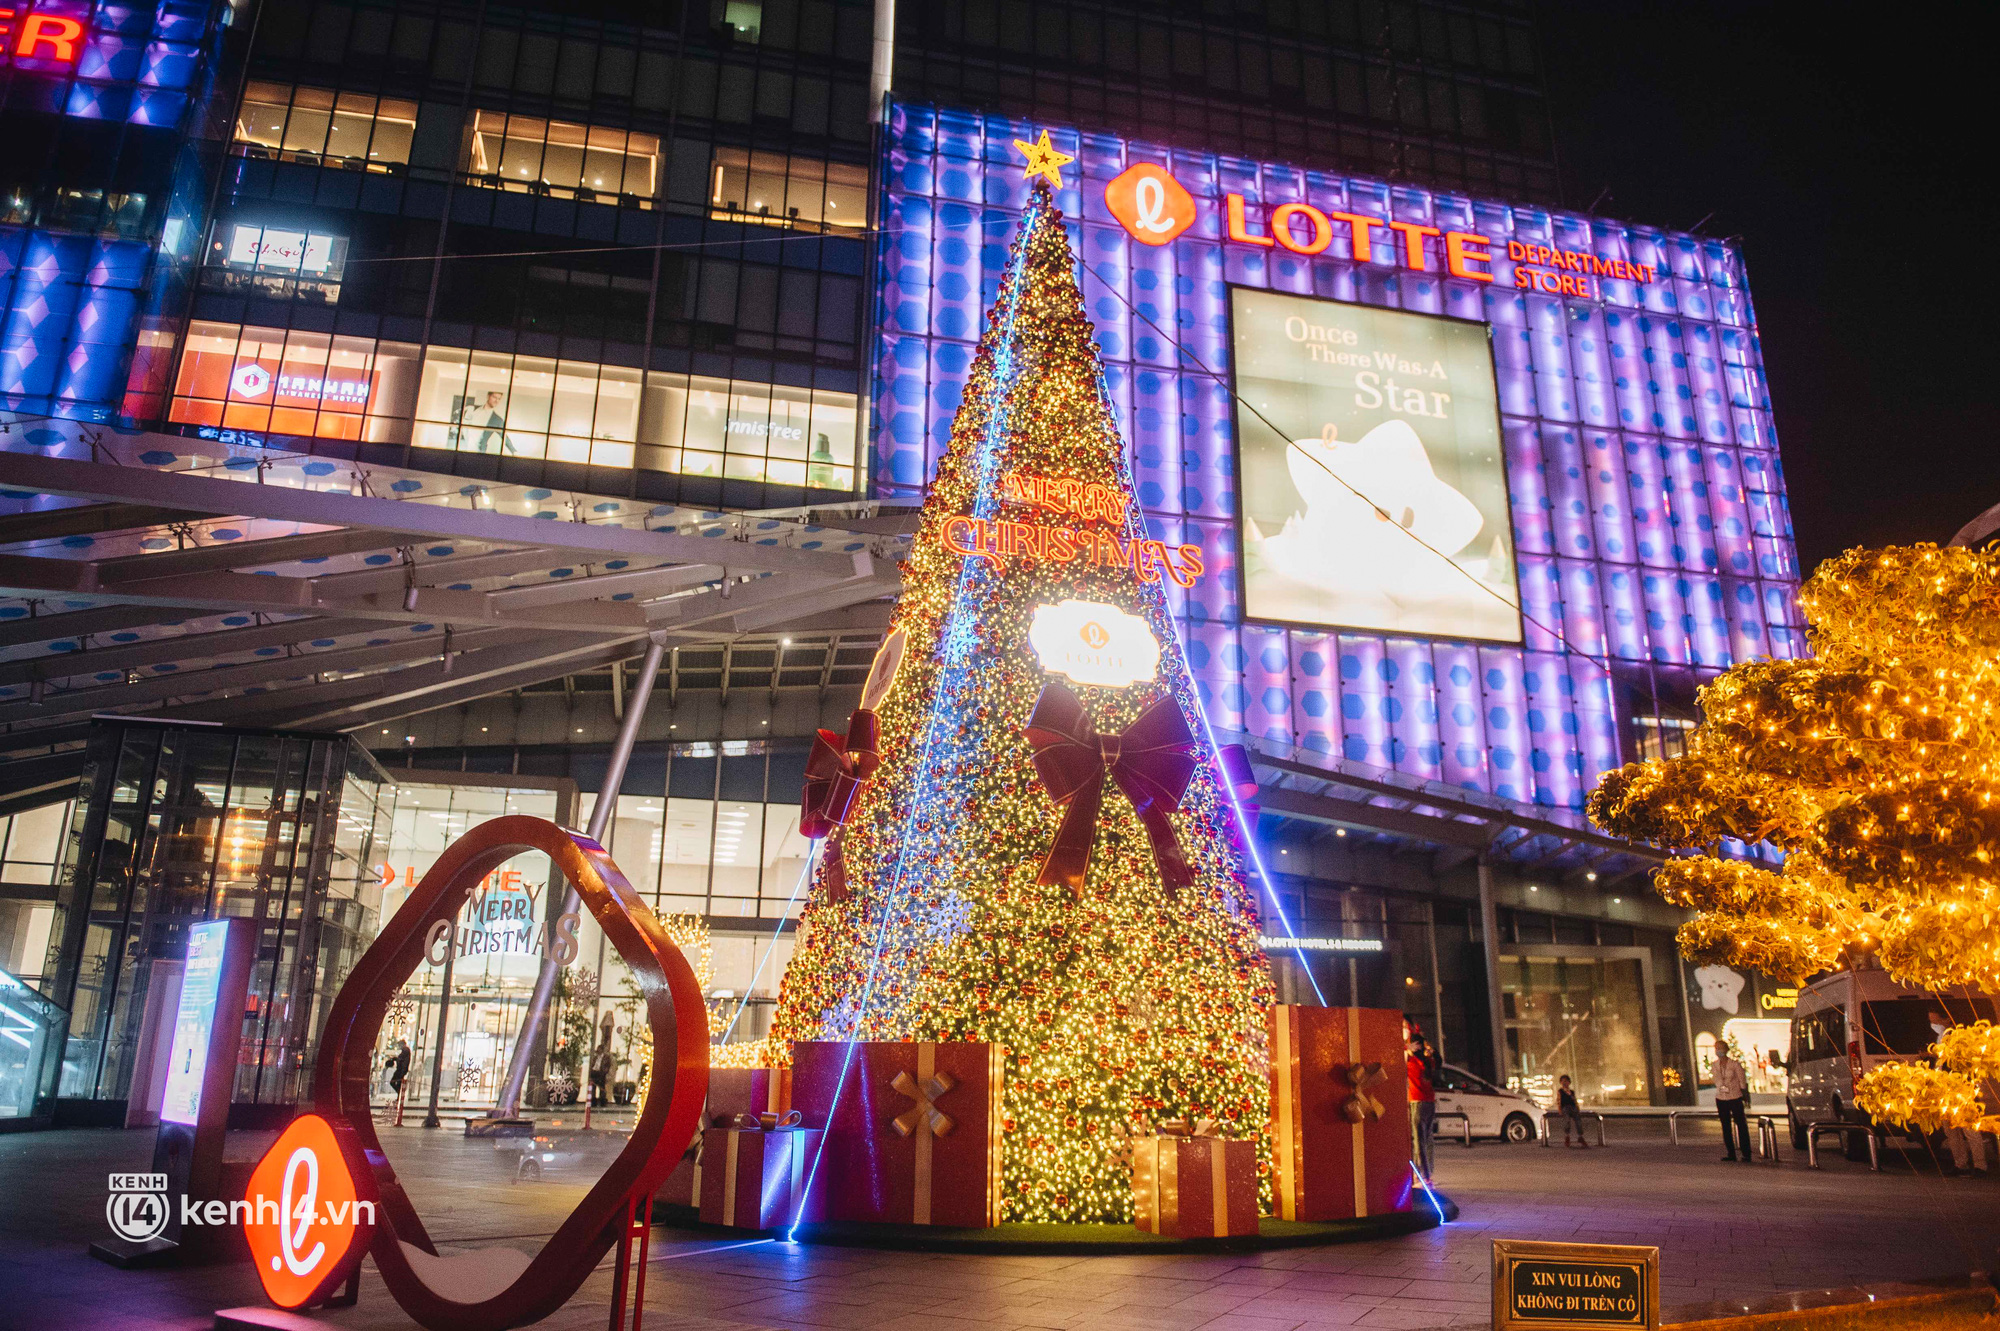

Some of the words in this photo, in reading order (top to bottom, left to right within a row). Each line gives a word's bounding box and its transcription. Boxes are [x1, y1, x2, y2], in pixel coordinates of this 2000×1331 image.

[0, 8, 83, 61] R
[1227, 193, 1494, 282] LOTTE
[1508, 240, 1656, 283] DEPARTMENT
[1514, 266, 1591, 298] STORE
[1285, 316, 1358, 346] Once
[1306, 343, 1371, 369] There
[279, 376, 369, 397] MANWAH
[332, 394, 364, 404] HOTPO
[1354, 371, 1450, 419] Star
[724, 418, 802, 441] innisfree
[1004, 473, 1130, 525] MERRY
[941, 515, 1205, 588] CHRISTMAS
[404, 866, 522, 892] LTE
[465, 881, 546, 924] MERRY
[424, 913, 581, 967] CHRISTMAS
[1532, 1272, 1555, 1286] XIN
[1558, 1273, 1581, 1288] VUI
[1584, 1271, 1621, 1289] LÒNG
[1517, 1292, 1563, 1310] KHÔNG
[1566, 1296, 1580, 1310] ĐI
[1582, 1294, 1615, 1312] TRÊN
[1618, 1294, 1636, 1312] CỎ
